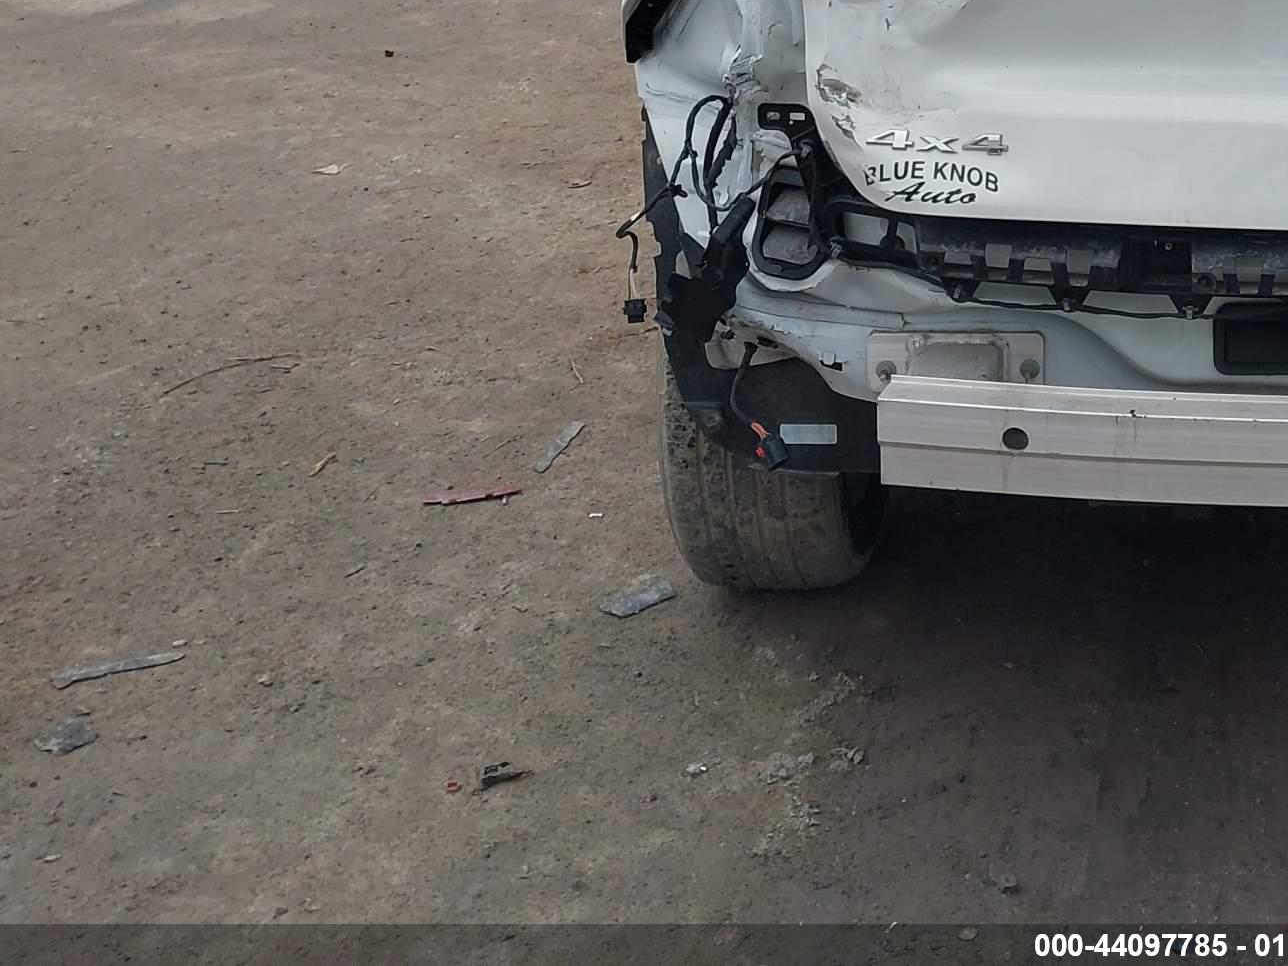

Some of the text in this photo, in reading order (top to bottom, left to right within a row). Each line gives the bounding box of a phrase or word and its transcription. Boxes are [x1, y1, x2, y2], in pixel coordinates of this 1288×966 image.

[866, 129, 1009, 155] 4x4
[863, 160, 999, 192] BLUE KNOB
[884, 181, 976, 204] Auto
